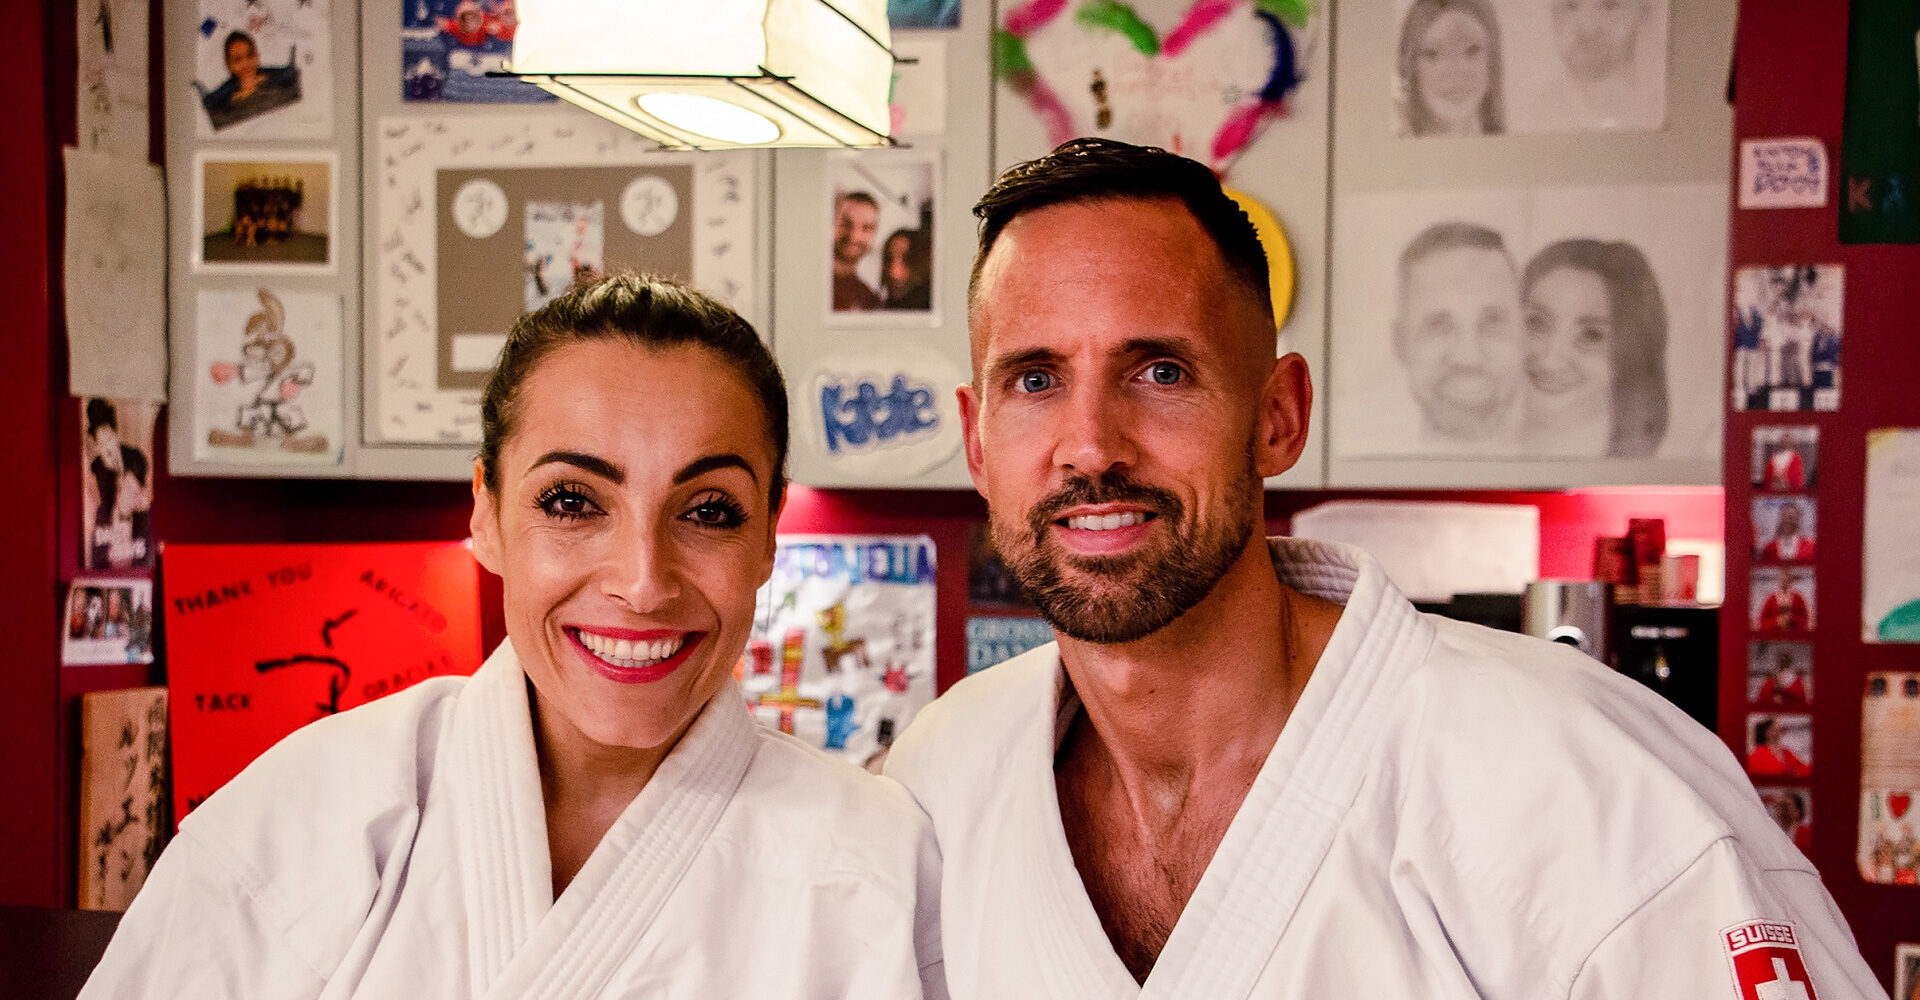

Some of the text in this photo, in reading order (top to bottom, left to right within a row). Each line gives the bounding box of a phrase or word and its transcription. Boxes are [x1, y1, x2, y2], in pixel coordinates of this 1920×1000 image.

[175, 562, 313, 616] THANK YOU
[195, 693, 252, 712] TACK
[1729, 925, 1794, 949] SUISSE
